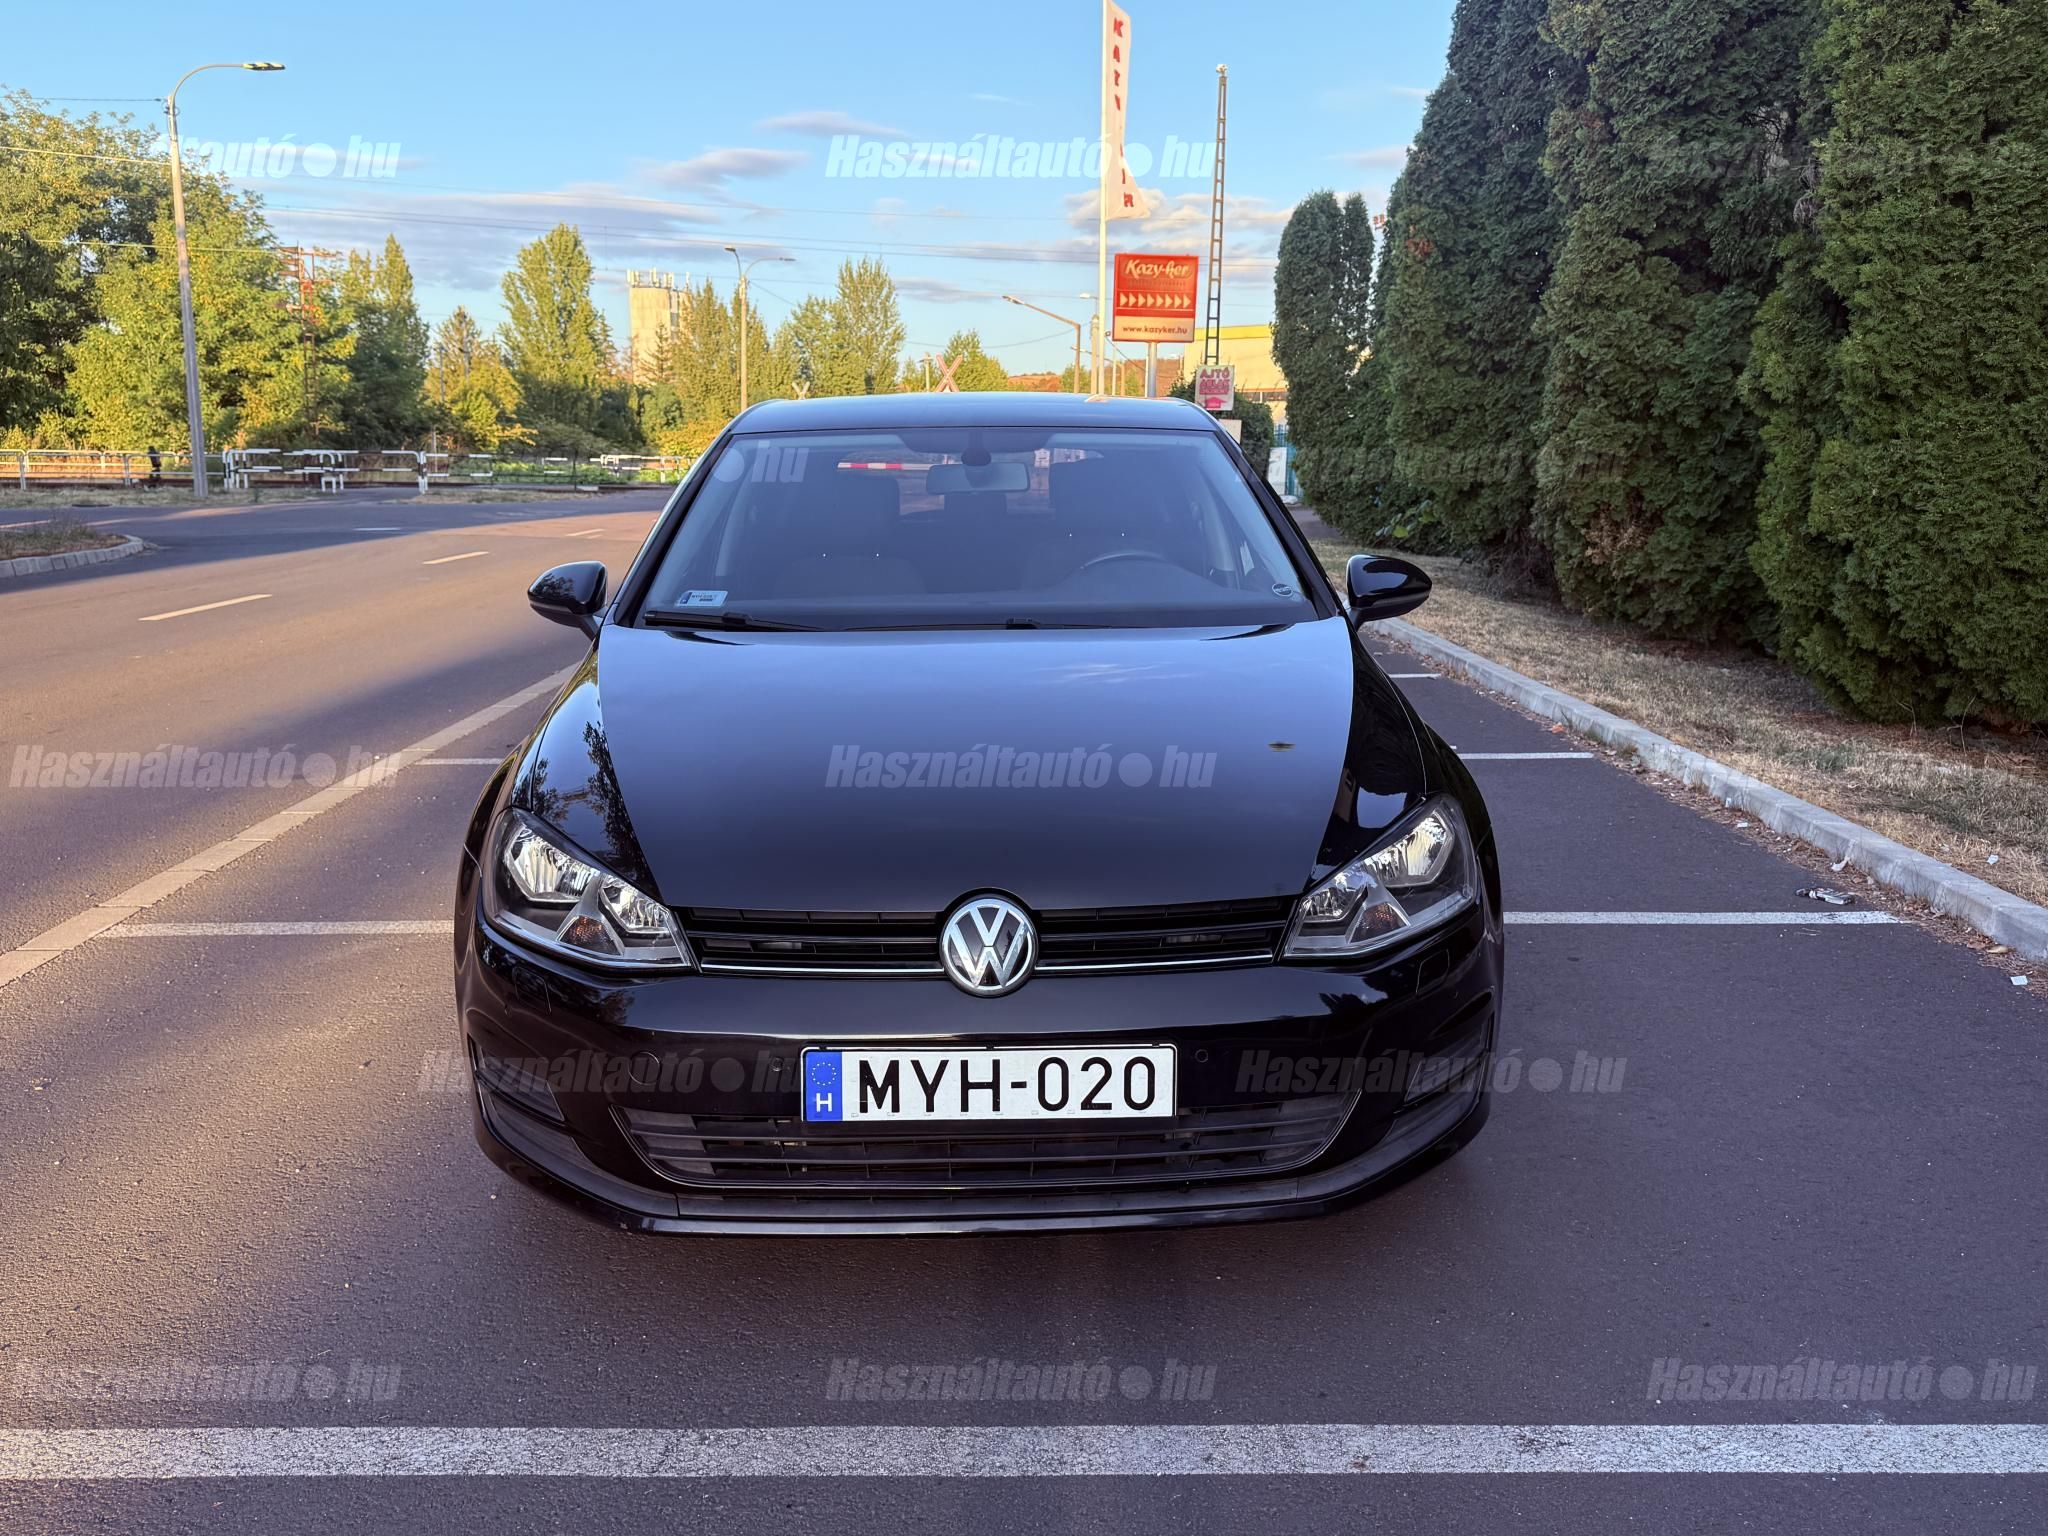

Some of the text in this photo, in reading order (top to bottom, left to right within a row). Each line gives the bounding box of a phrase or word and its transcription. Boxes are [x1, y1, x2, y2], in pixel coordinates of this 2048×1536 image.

[1122, 325, 1188, 335] www.kazyker.hu
[816, 1056, 1157, 1114] H MYH-020
